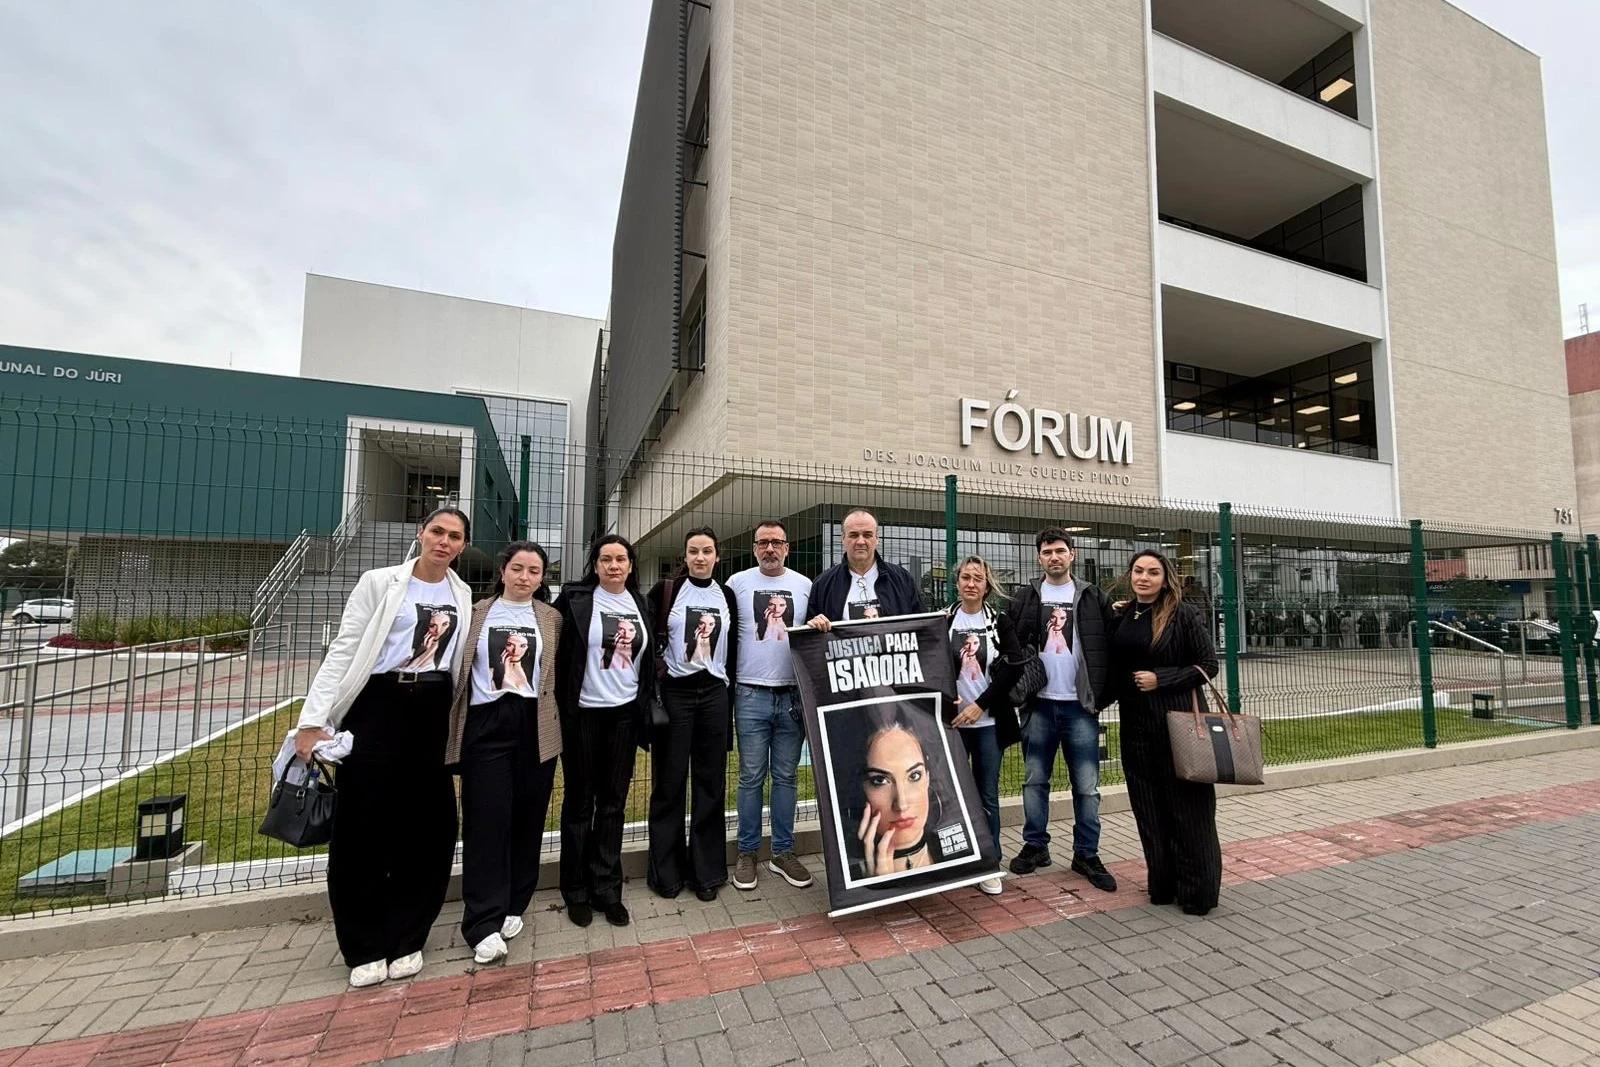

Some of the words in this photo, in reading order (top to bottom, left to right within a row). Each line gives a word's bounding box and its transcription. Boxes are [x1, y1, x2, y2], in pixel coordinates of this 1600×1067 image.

[0, 361, 46, 376] UNAL
[53, 367, 79, 379] DO
[85, 368, 122, 384] JÚRI
[959, 389, 1134, 466] FÓRUM
[863, 447, 897, 464] DES.
[906, 452, 982, 472] JOAQUIM
[990, 461, 1023, 476] LUIZ
[1030, 465, 1085, 482] GUEDES
[1090, 471, 1132, 487] PINTO
[825, 635, 883, 660] JUSTIÇA
[885, 632, 919, 653] PARA
[827, 652, 925, 693] ISADORA
